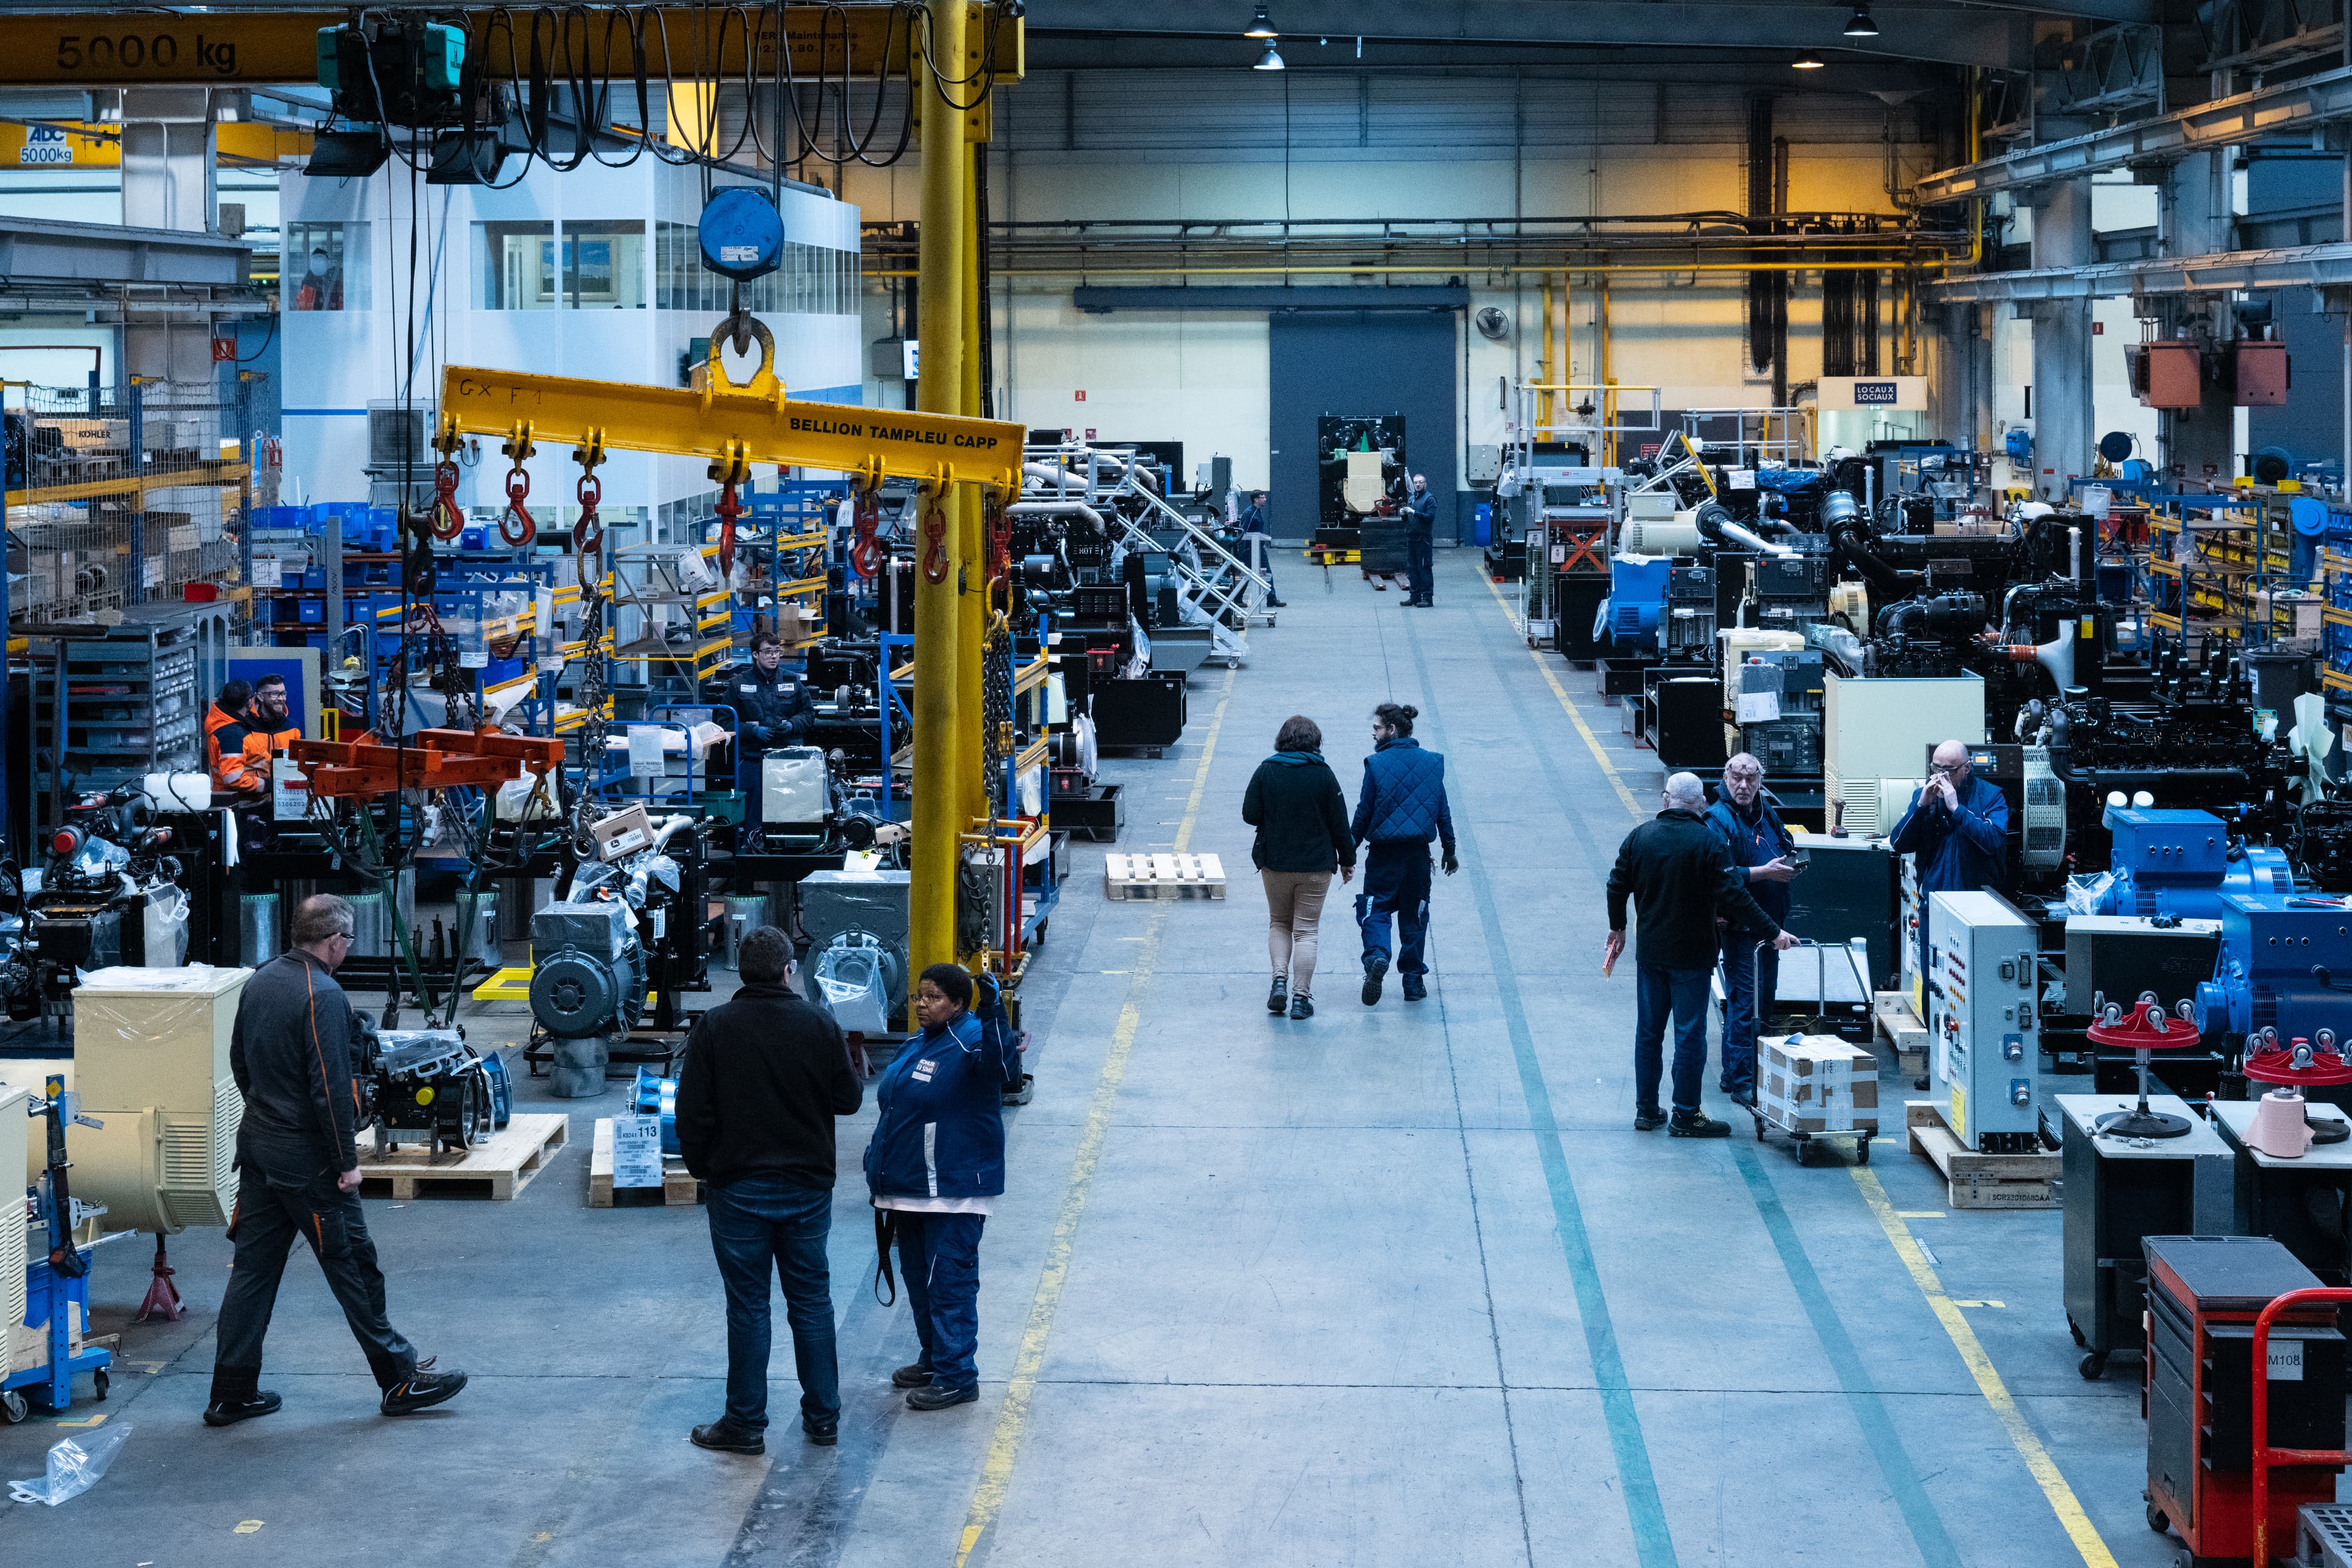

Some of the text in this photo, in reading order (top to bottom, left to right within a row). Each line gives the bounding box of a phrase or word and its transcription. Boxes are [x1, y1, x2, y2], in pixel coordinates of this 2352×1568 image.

[58, 34, 236, 74] 5000 kg
[28, 127, 64, 142] ADC
[21, 148, 72, 162] 5000kg
[790, 418, 998, 450] BELLION TAMPLEU CAPP
[638, 1126, 657, 1137] 113
[2268, 1355, 2301, 1366] M108
